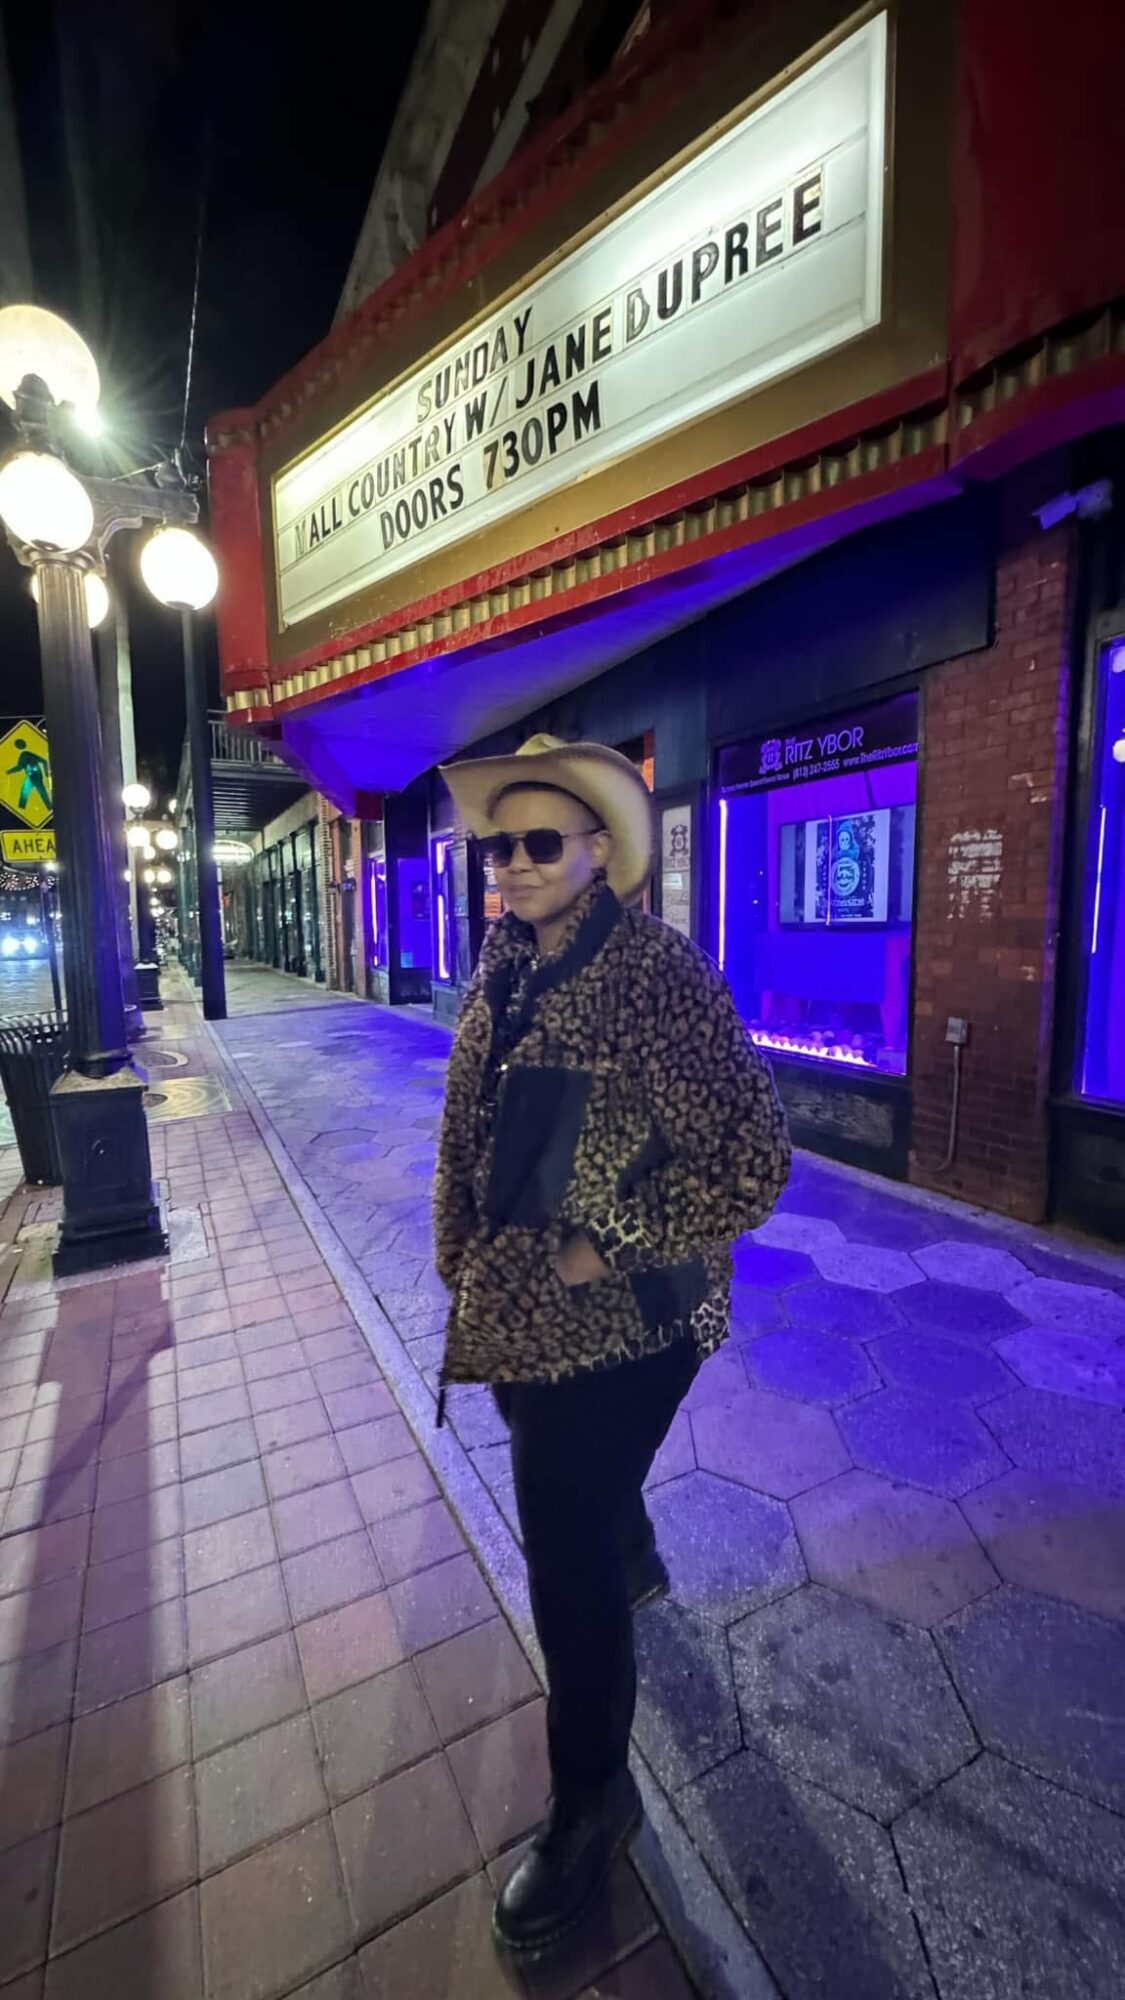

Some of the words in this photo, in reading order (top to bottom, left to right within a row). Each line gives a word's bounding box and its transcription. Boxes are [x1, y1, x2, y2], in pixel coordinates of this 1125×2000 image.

[295, 497, 342, 555] YALL
[349, 412, 456, 517] COUNTRY
[465, 376, 508, 441] W/
[516, 306, 612, 409] JANE
[626, 173, 821, 343] DUPREE
[417, 306, 533, 423] SUNDAY
[380, 464, 464, 550] DOORS
[484, 380, 600, 490] 730PM
[785, 740, 813, 765] RITZ
[817, 726, 864, 756] YBOR
[12, 838, 56, 853] AHEA
